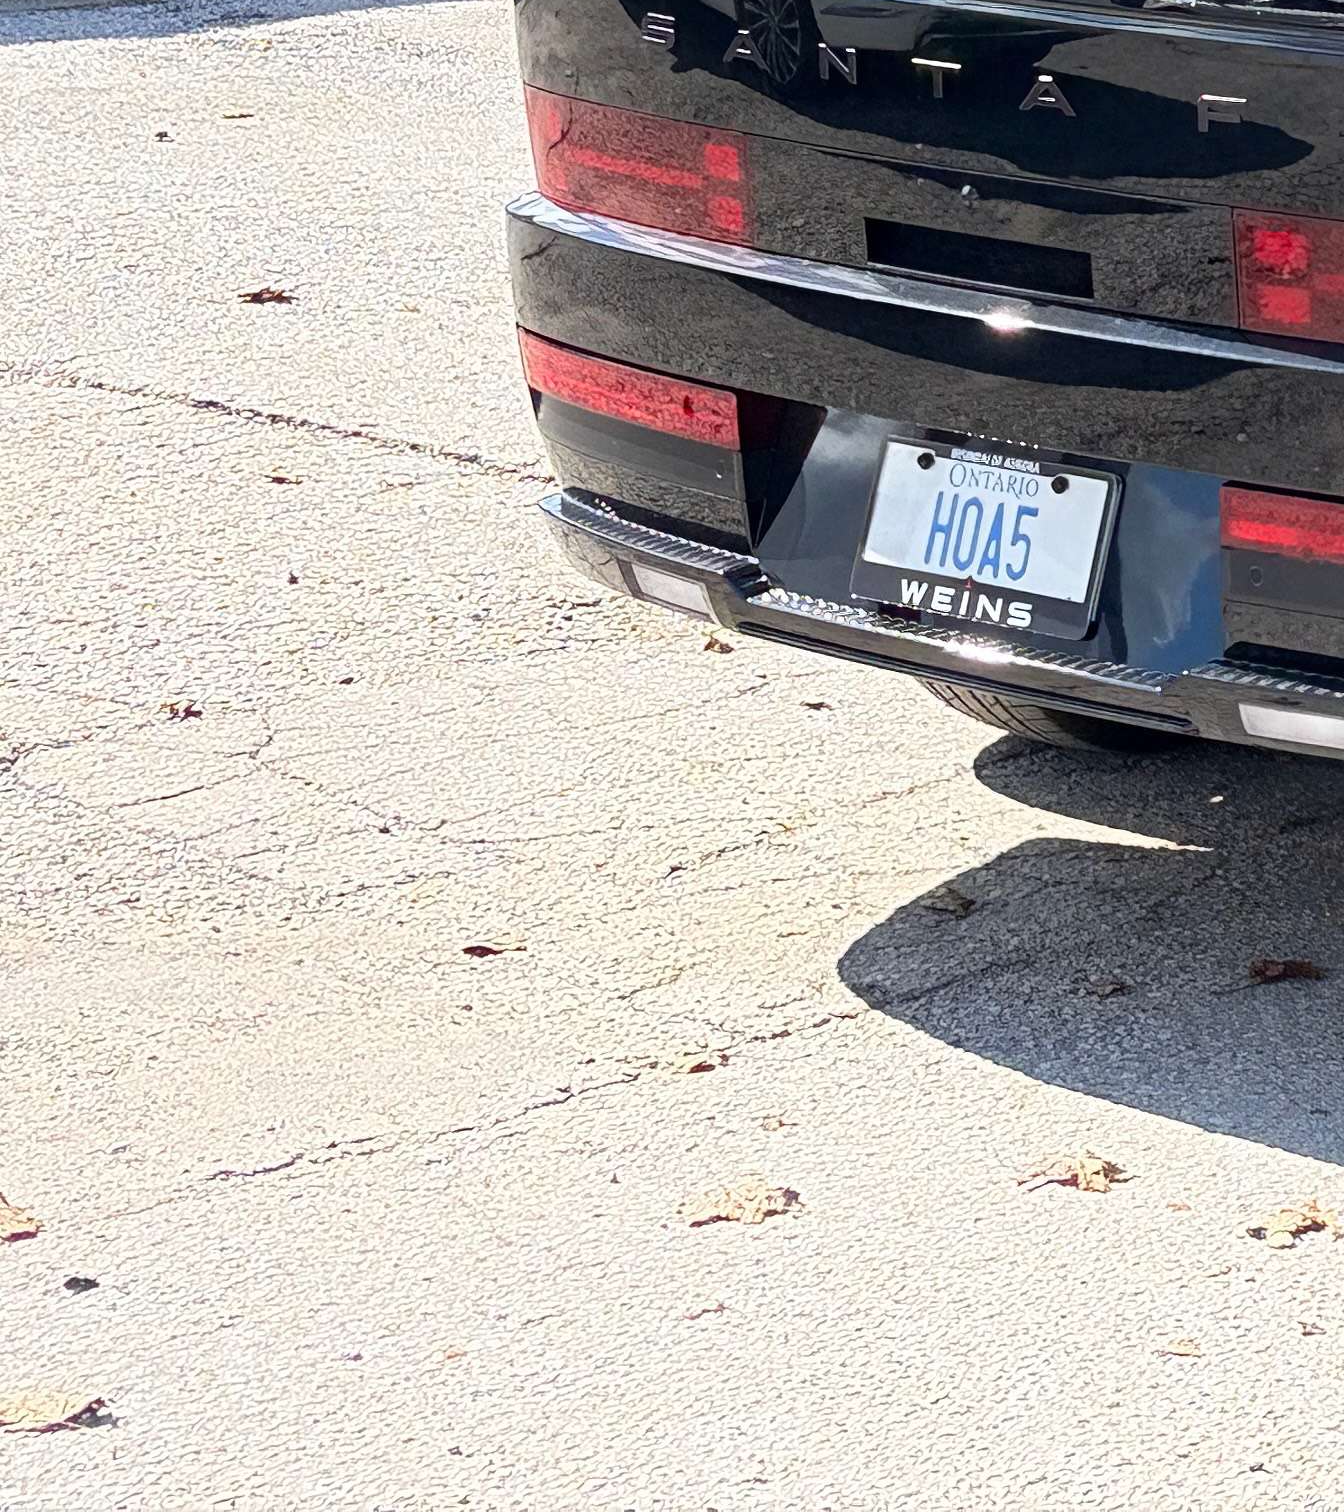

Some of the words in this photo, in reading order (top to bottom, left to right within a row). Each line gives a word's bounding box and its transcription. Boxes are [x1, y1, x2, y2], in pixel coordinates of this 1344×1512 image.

[641, 11, 1077, 118] SANTA
[950, 463, 1039, 499] ONTARIO
[901, 578, 1033, 628] WEINS
